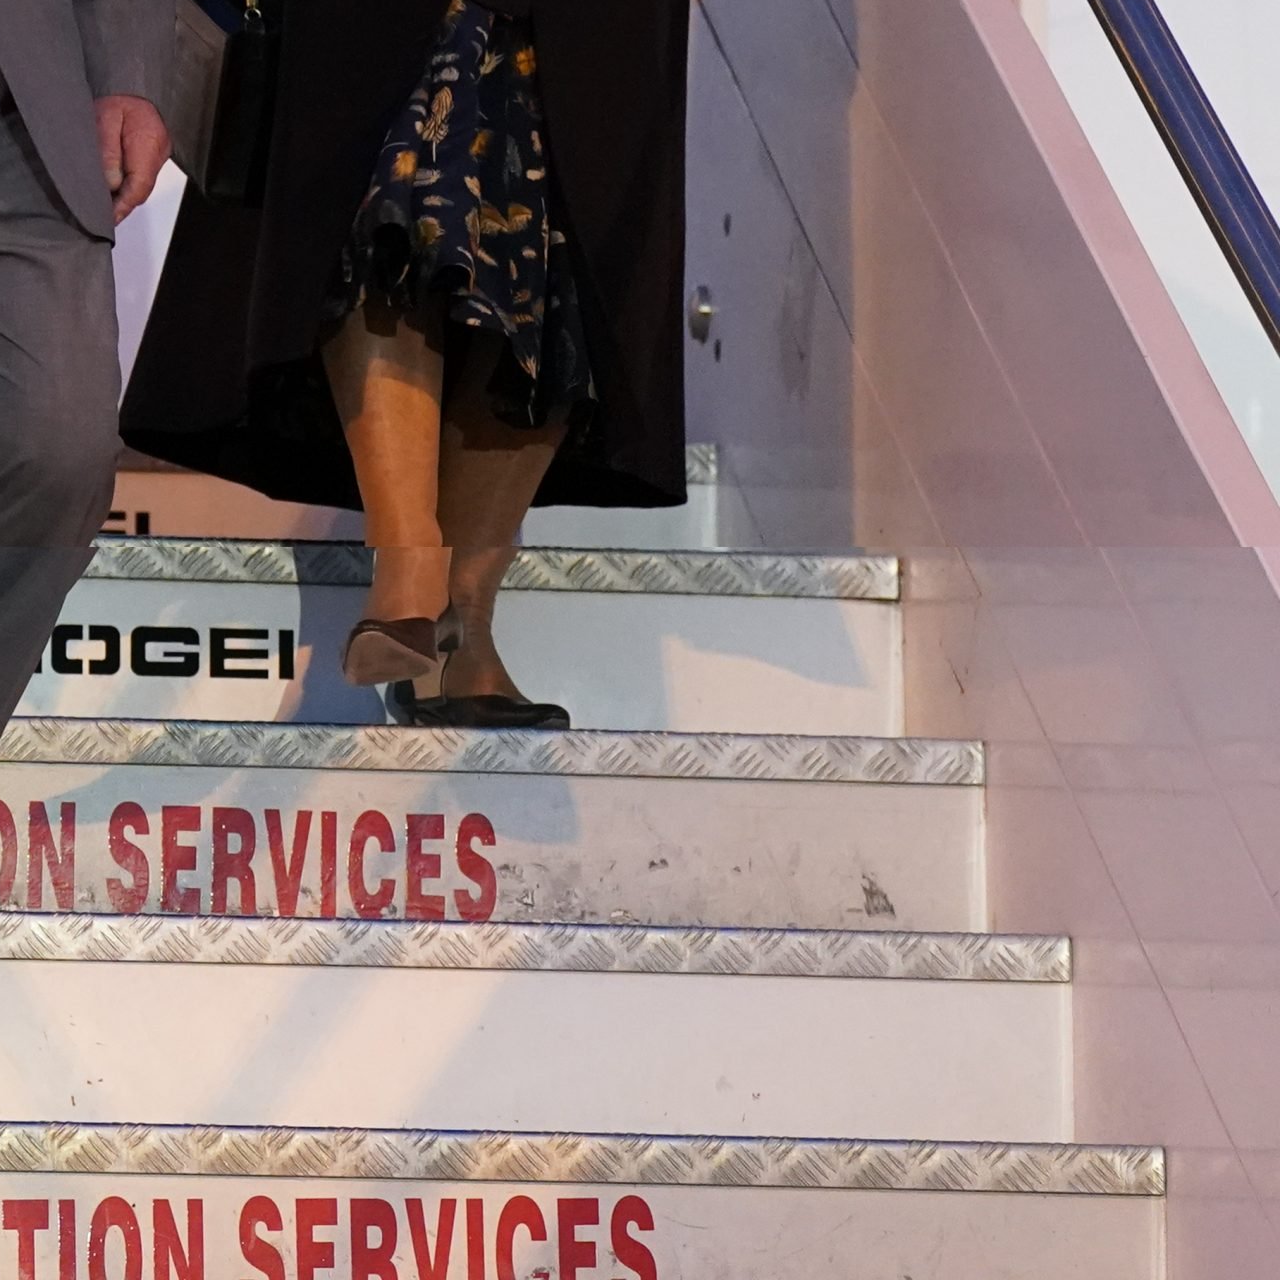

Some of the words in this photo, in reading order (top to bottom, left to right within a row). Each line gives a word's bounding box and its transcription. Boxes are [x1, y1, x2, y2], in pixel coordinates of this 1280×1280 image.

[33, 624, 295, 680] OGEI
[105, 803, 498, 922] SERVICES
[238, 1194, 658, 1280] SERVICES
